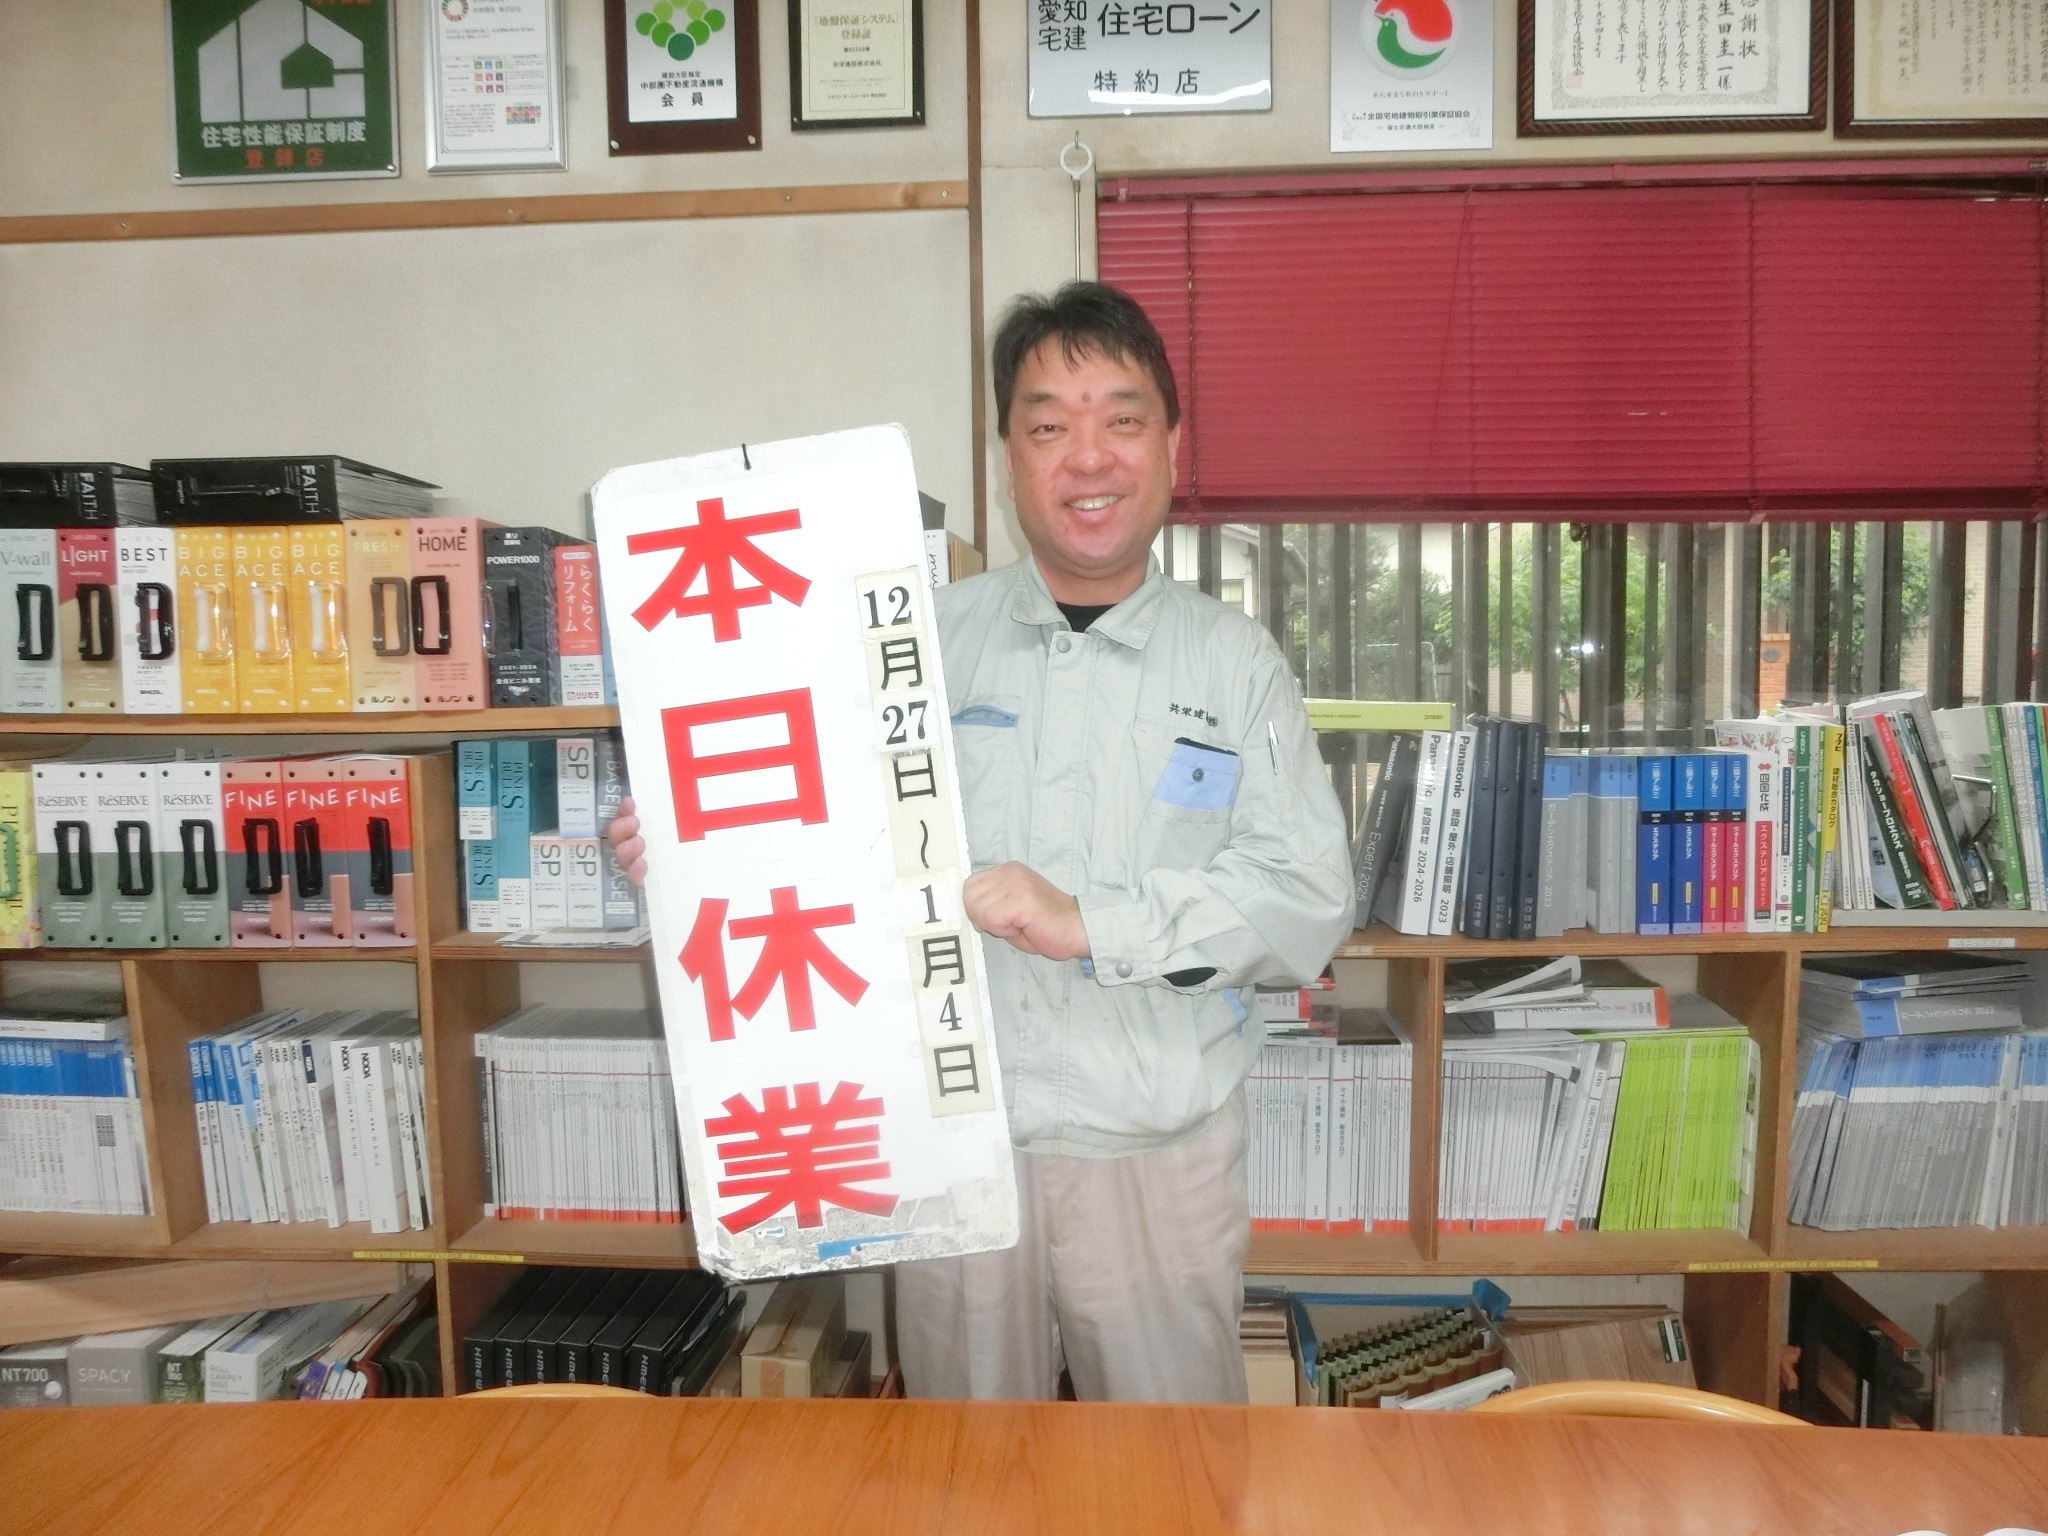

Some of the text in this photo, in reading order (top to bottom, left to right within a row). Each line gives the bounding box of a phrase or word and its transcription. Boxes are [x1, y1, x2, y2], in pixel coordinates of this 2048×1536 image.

[1097, 2, 1260, 37] 住宅ローン
[1038, 25, 1087, 51] 宅建
[640, 78, 724, 90] 中部圏不動産流通機構
[1094, 68, 1200, 94] 特約店
[661, 91, 703, 107] 会員
[201, 120, 366, 148] 住宅性能保証制度
[79, 472, 99, 520] FAITH
[301, 464, 320, 513] FAITH
[61, 545, 108, 567] LIGHT
[121, 548, 168, 561] BEST
[179, 546, 225, 559] BIG
[235, 545, 283, 558] BIG
[292, 544, 340, 558] BIG
[419, 536, 468, 552] HOME
[0, 551, 50, 566] V-wall
[180, 563, 225, 577] ACE
[236, 563, 283, 577] ACE
[293, 561, 340, 575] ACE
[486, 555, 540, 565] POWER1000
[563, 565, 578, 632] リフォーム
[580, 564, 594, 632] らくらく
[568, 746, 589, 780] SP
[1384, 735, 1401, 781] Panasonic
[1452, 735, 1471, 799] Panasonic
[224, 789, 277, 811] FINE
[286, 788, 340, 810] FINE
[345, 787, 402, 809] FINE
[1760, 773, 1770, 812] 四国化成
[540, 844, 562, 877] SP
[576, 844, 597, 877] SP
[1364, 832, 1382, 872] Expert
[1760, 824, 1768, 875] エクステリア
[628, 498, 899, 1235] 本日休業
[1413, 850, 1427, 903] 2024-2026
[1545, 885, 1554, 908] 2023
[1438, 899, 1449, 924] 2023
[340, 1045, 350, 1072] NODA
[361, 1052, 371, 1080] NODA
[78, 1368, 131, 1383] SPACY
